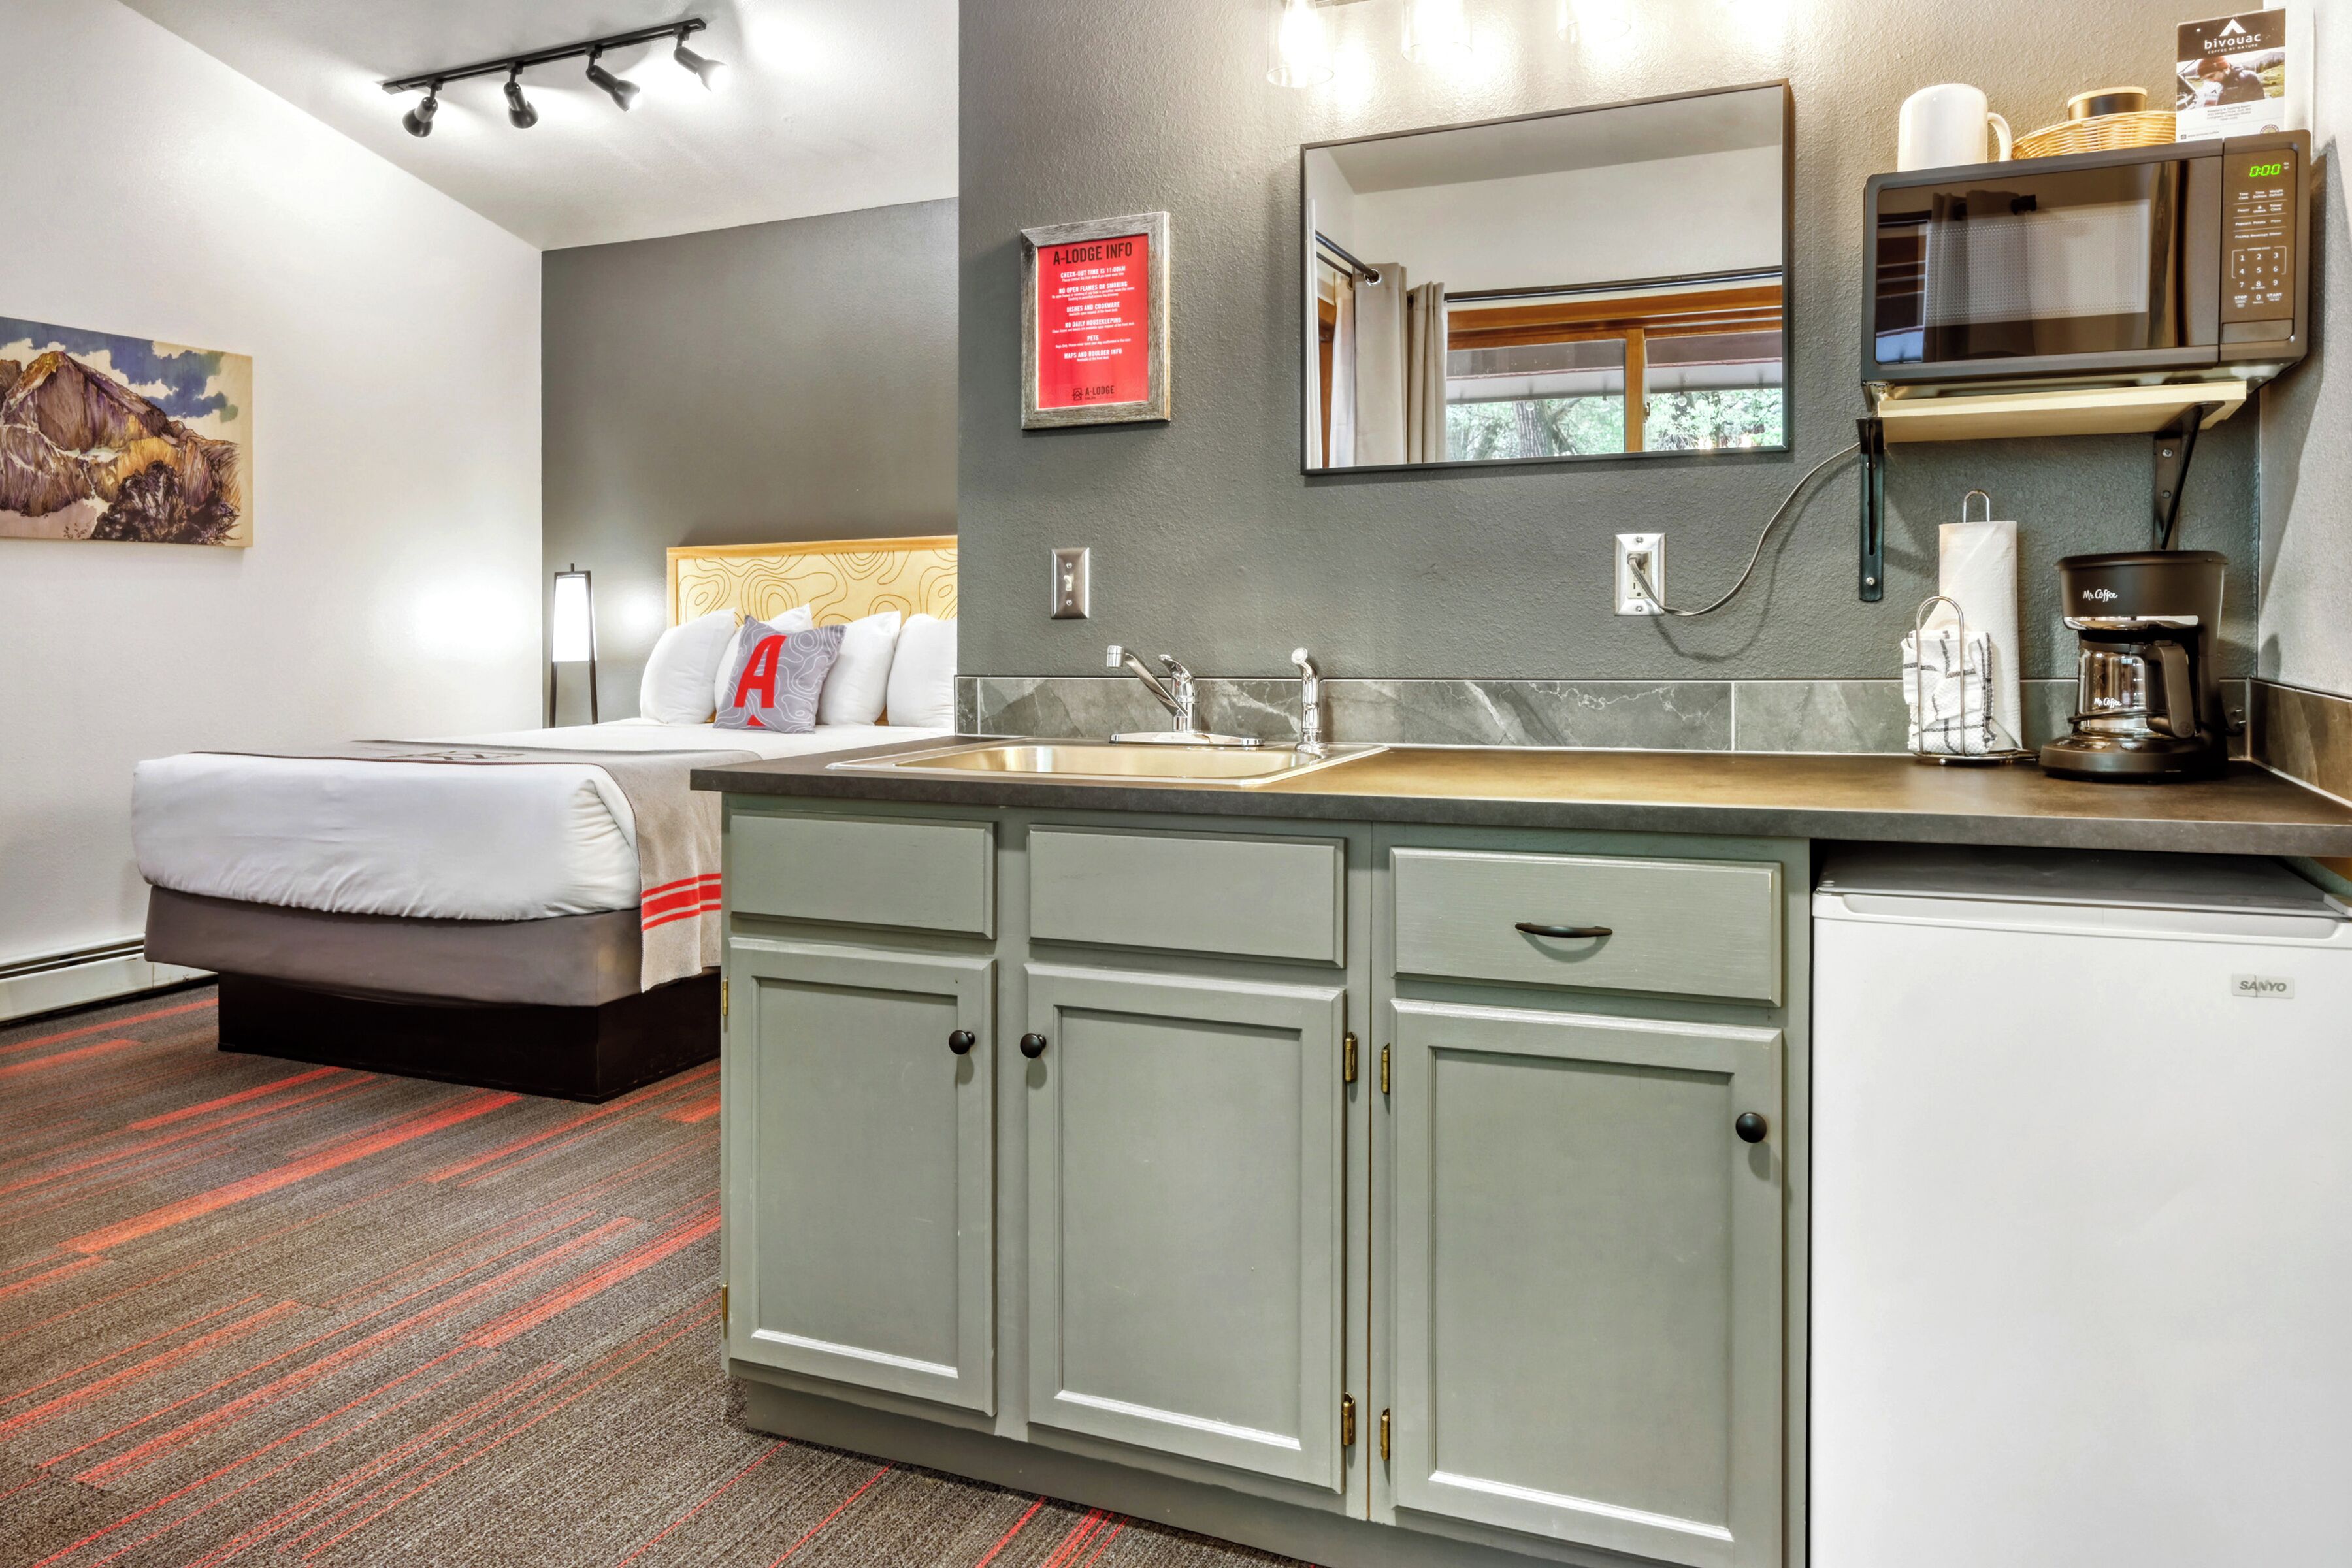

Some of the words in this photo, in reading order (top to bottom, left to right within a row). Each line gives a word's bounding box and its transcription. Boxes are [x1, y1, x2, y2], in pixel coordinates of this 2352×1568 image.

[2204, 33, 2261, 49] bivouac
[2249, 164, 2281, 177] 0:00
[1053, 246, 1102, 265] A-LODGE
[1106, 242, 1132, 259] INFO
[1060, 270, 1086, 278] CHECK-OUT
[1095, 302, 1120, 310] COOKWARE
[1086, 317, 1121, 326] HOUSEKEEPING
[2083, 590, 2094, 601] Mr.
[2095, 589, 2118, 602] Coffee
[733, 634, 787, 709] A
[2094, 697, 2103, 706] Mr.
[2104, 697, 2122, 709] Coffee
[2239, 980, 2287, 992] SANYO
